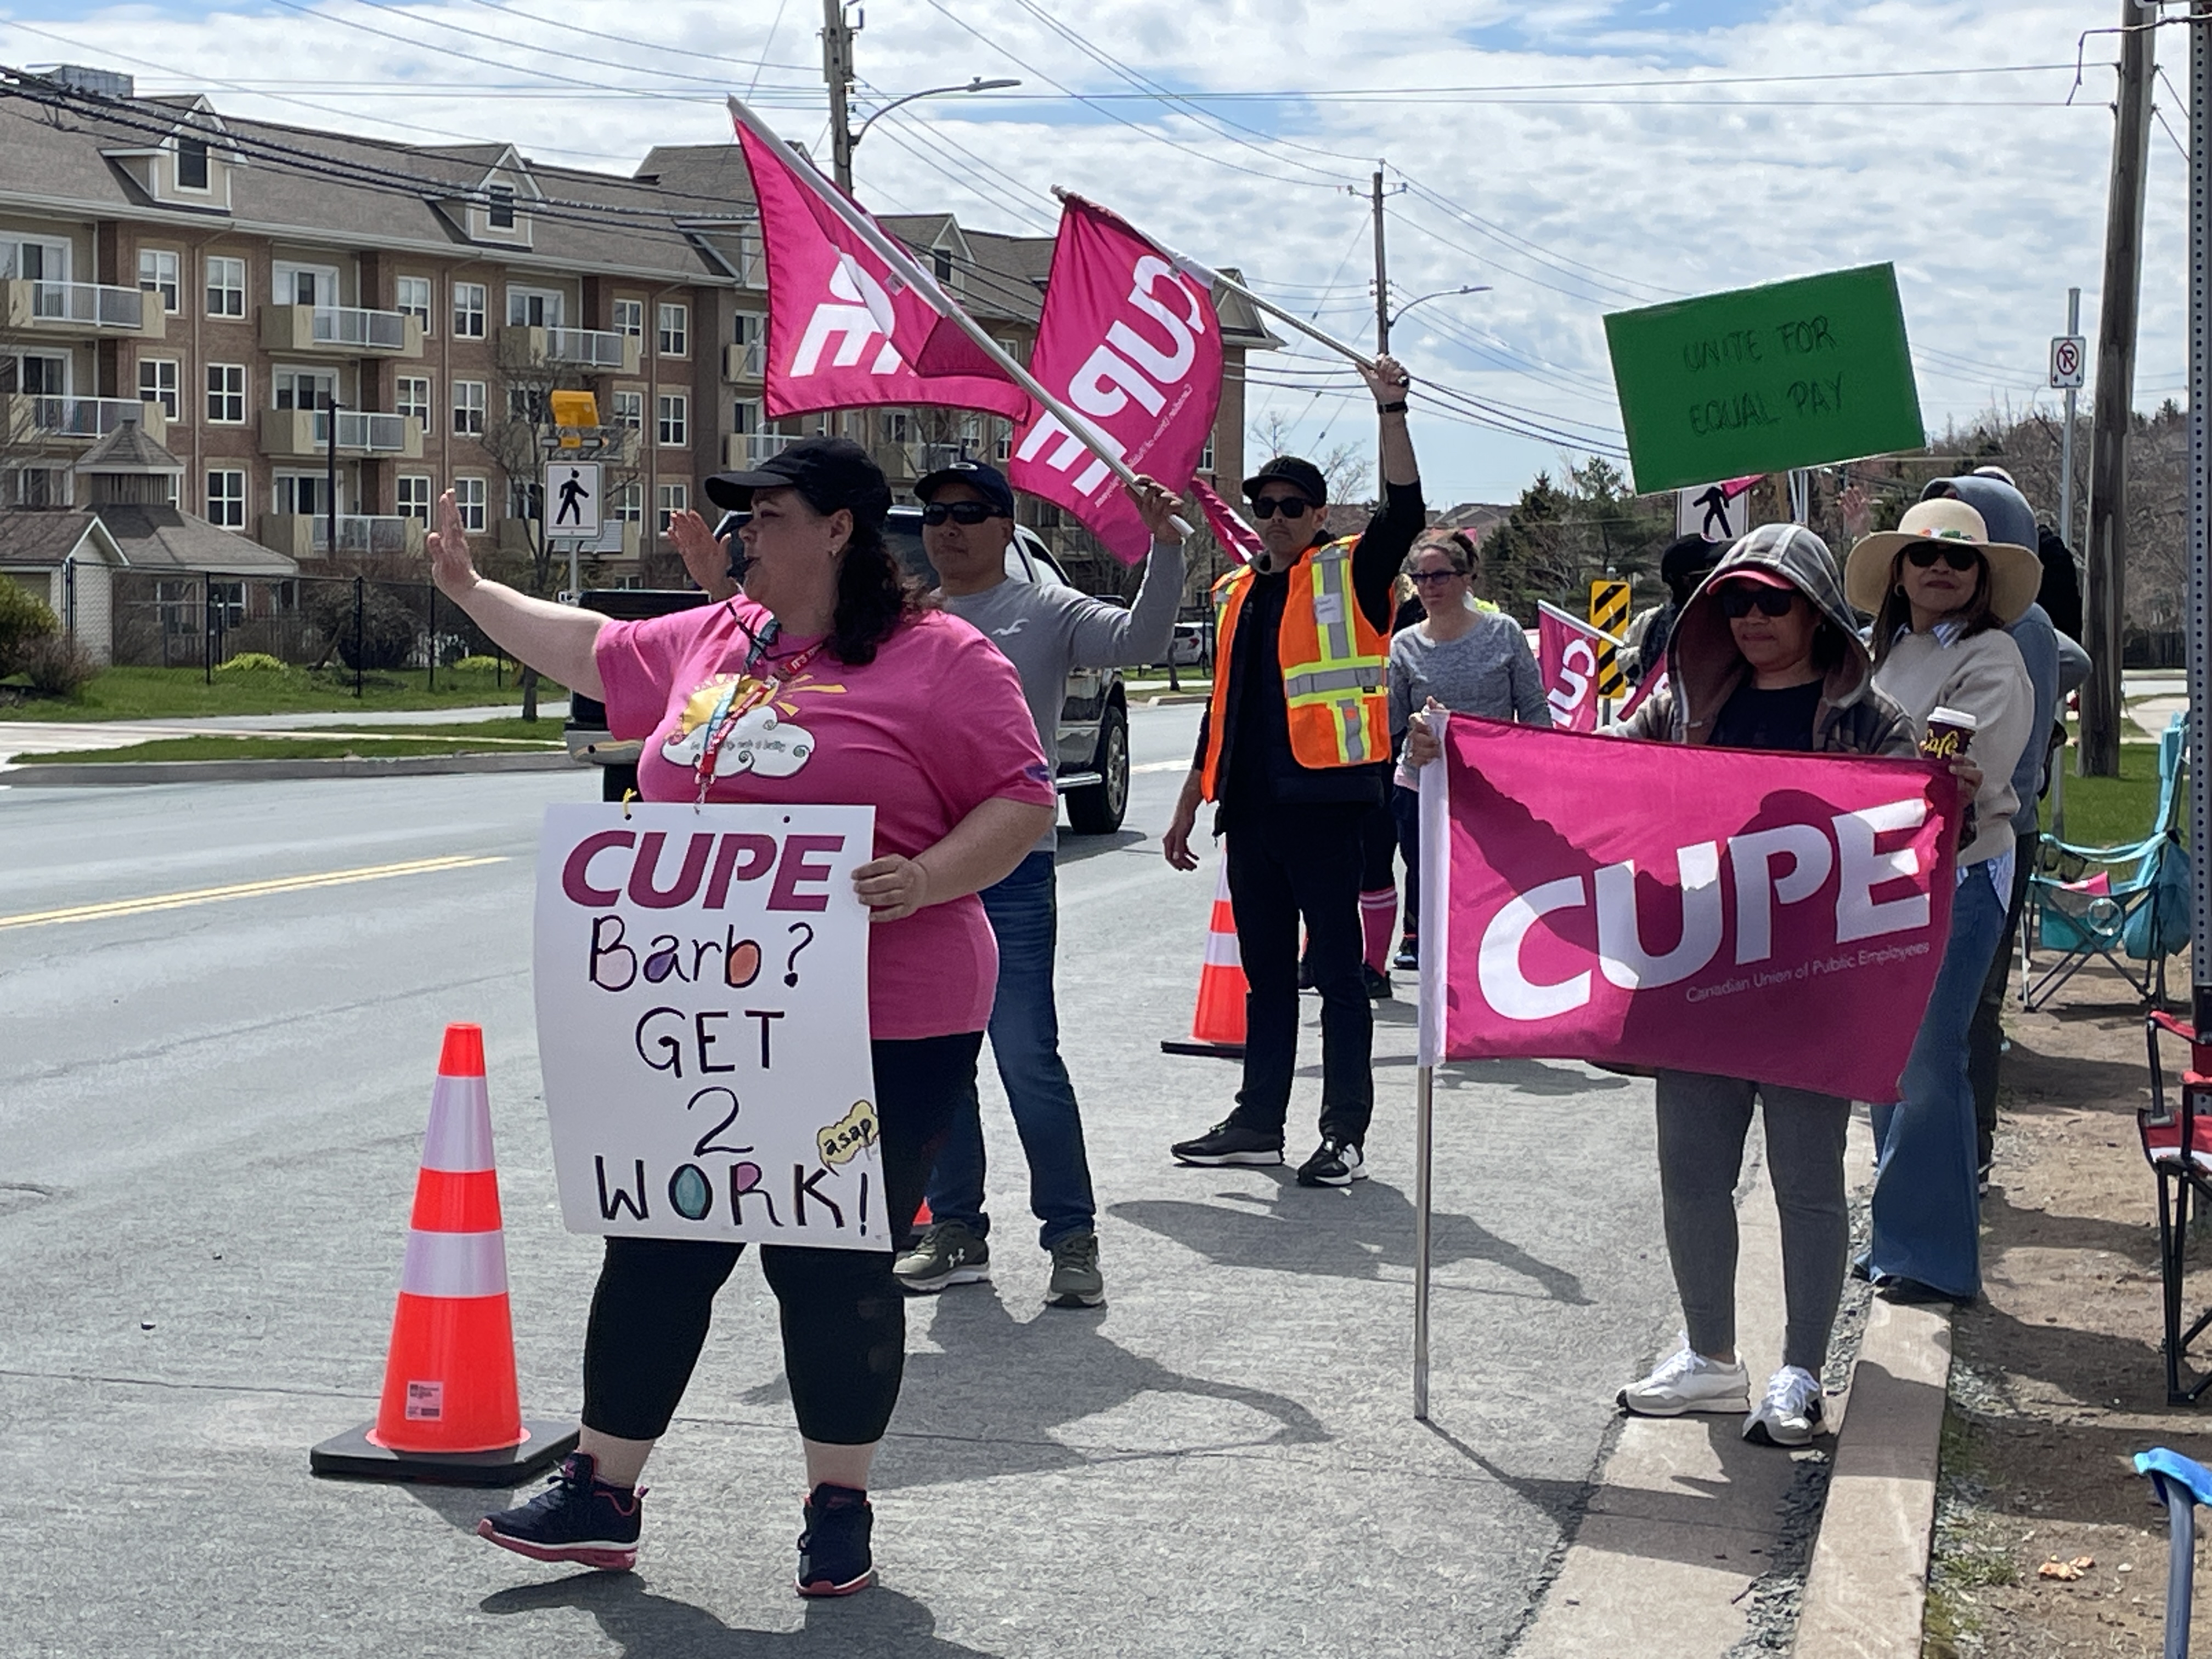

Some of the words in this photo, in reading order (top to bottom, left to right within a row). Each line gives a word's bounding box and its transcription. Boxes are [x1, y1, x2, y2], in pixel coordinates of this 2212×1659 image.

[1683, 330, 1763, 371] UNITE
[1776, 315, 1836, 354] FOR
[1690, 391, 1781, 435] EQUAL
[1787, 371, 1843, 417] PAY
[562, 830, 845, 912] CUPE
[1478, 798, 1930, 1020] CUPE
[1686, 979, 1751, 1003] Canadian
[1754, 967, 1792, 988] Union
[1795, 964, 1809, 979] of
[1812, 956, 1858, 974] Public
[1859, 941, 1931, 966] Employees
[636, 1007, 785, 1078] GET
[687, 1086, 754, 1157] 2
[823, 1118, 872, 1158] asap
